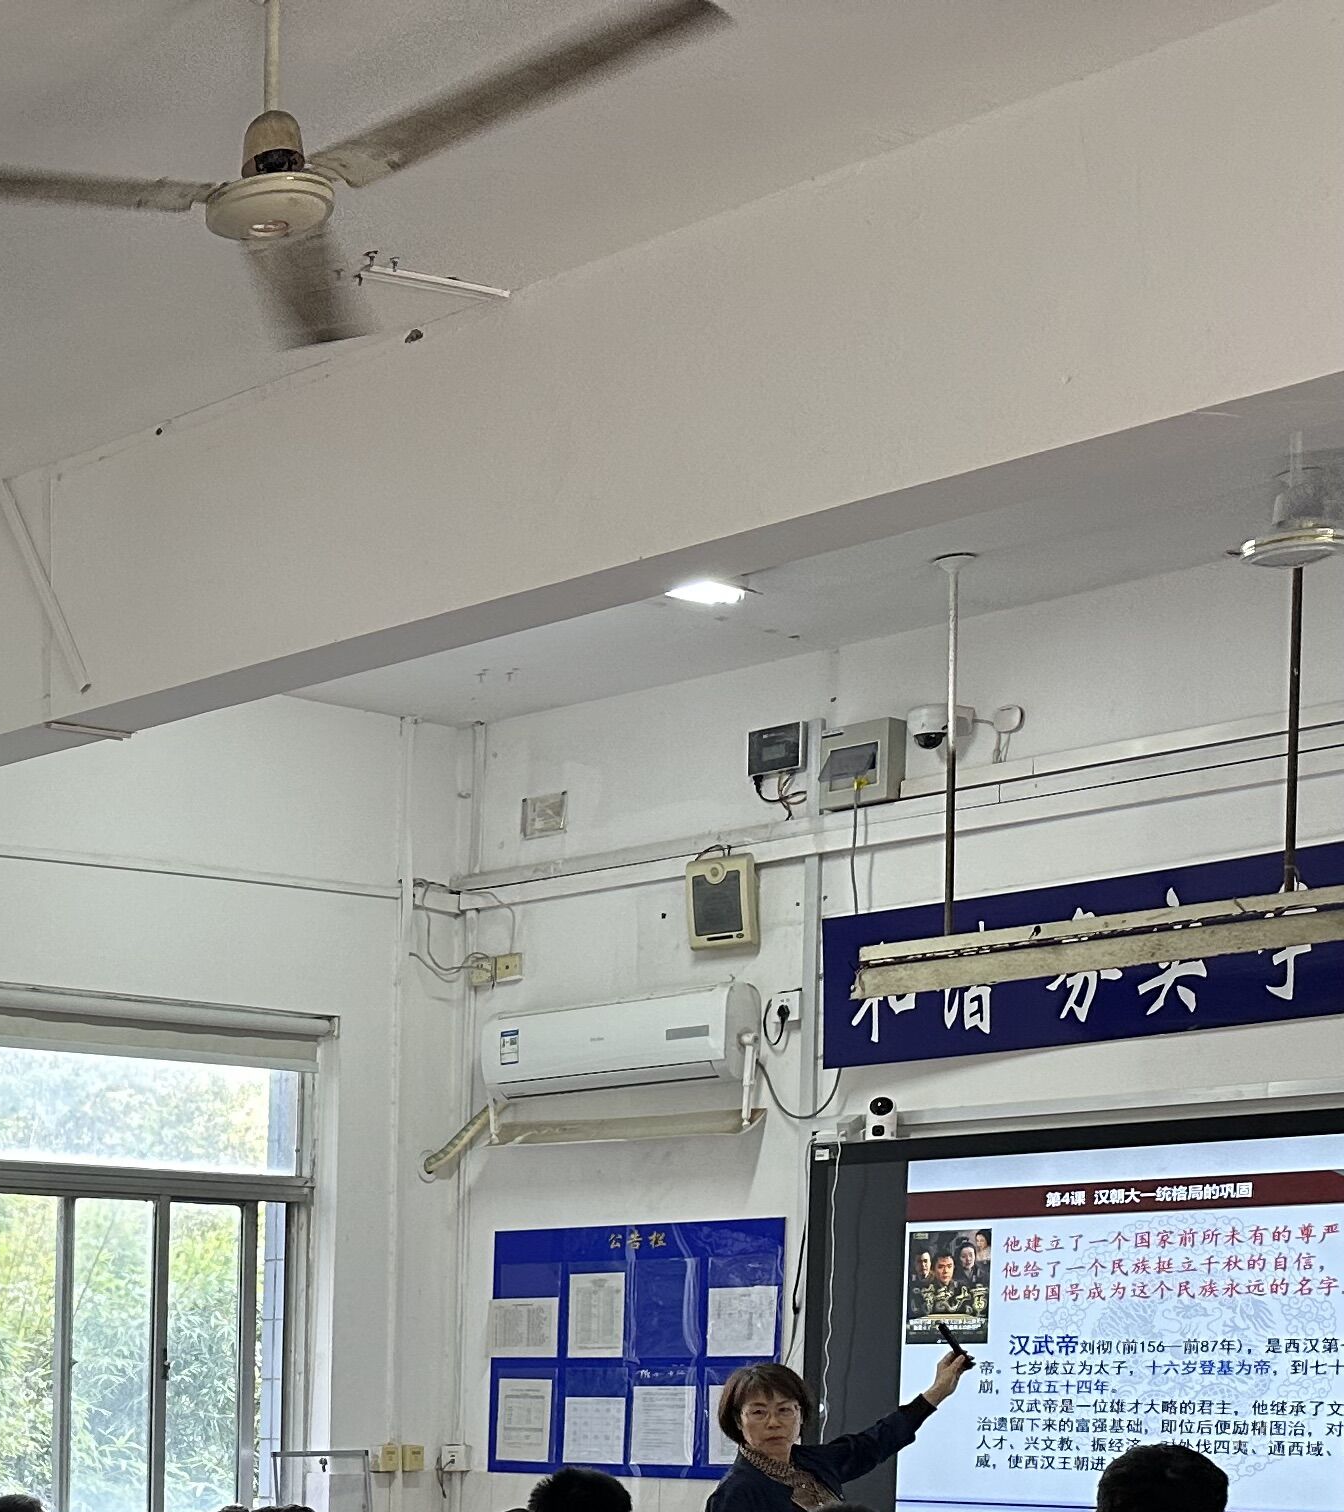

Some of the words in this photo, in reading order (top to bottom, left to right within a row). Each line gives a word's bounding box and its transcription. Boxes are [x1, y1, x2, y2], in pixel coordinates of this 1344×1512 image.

[1045, 1189, 1086, 1208] 第4课
[1093, 1182, 1253, 1205] 汉朝大一统格局的巩固
[975, 1454, 1117, 1472] 威，使西汉王朝进
